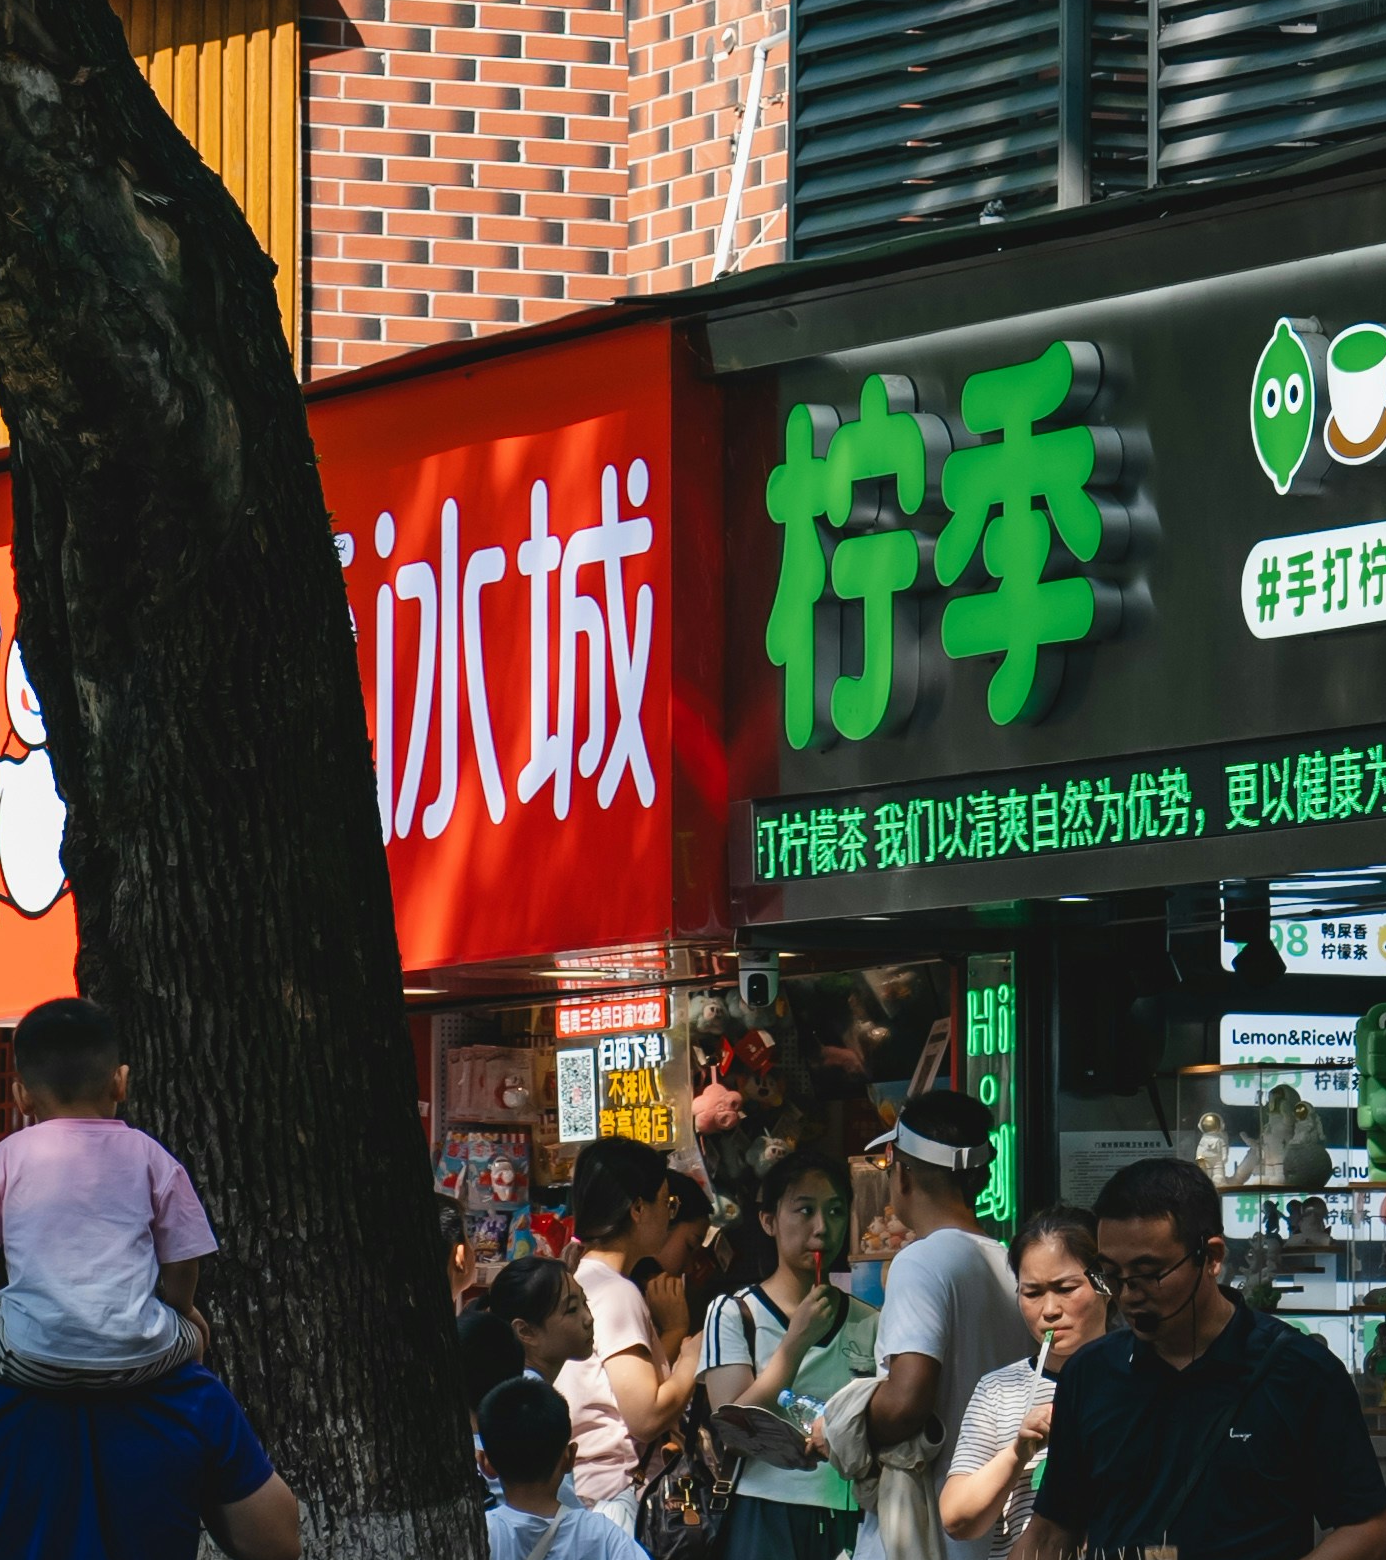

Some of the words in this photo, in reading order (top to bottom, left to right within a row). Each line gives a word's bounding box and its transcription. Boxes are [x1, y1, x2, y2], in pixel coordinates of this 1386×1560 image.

[765, 341, 1103, 751] 柠季
[335, 458, 656, 846] 冰城
[1263, 922, 1309, 958] 98
[1321, 922, 1368, 940] 鸭屎香
[1321, 942, 1369, 961] 柠檬茶
[559, 1001, 662, 1035] 每周三会员日满12减2
[966, 983, 1011, 1057] Hi
[598, 1034, 664, 1071] 扫码下单
[1231, 1028, 1357, 1046] Lemon&RiceWi
